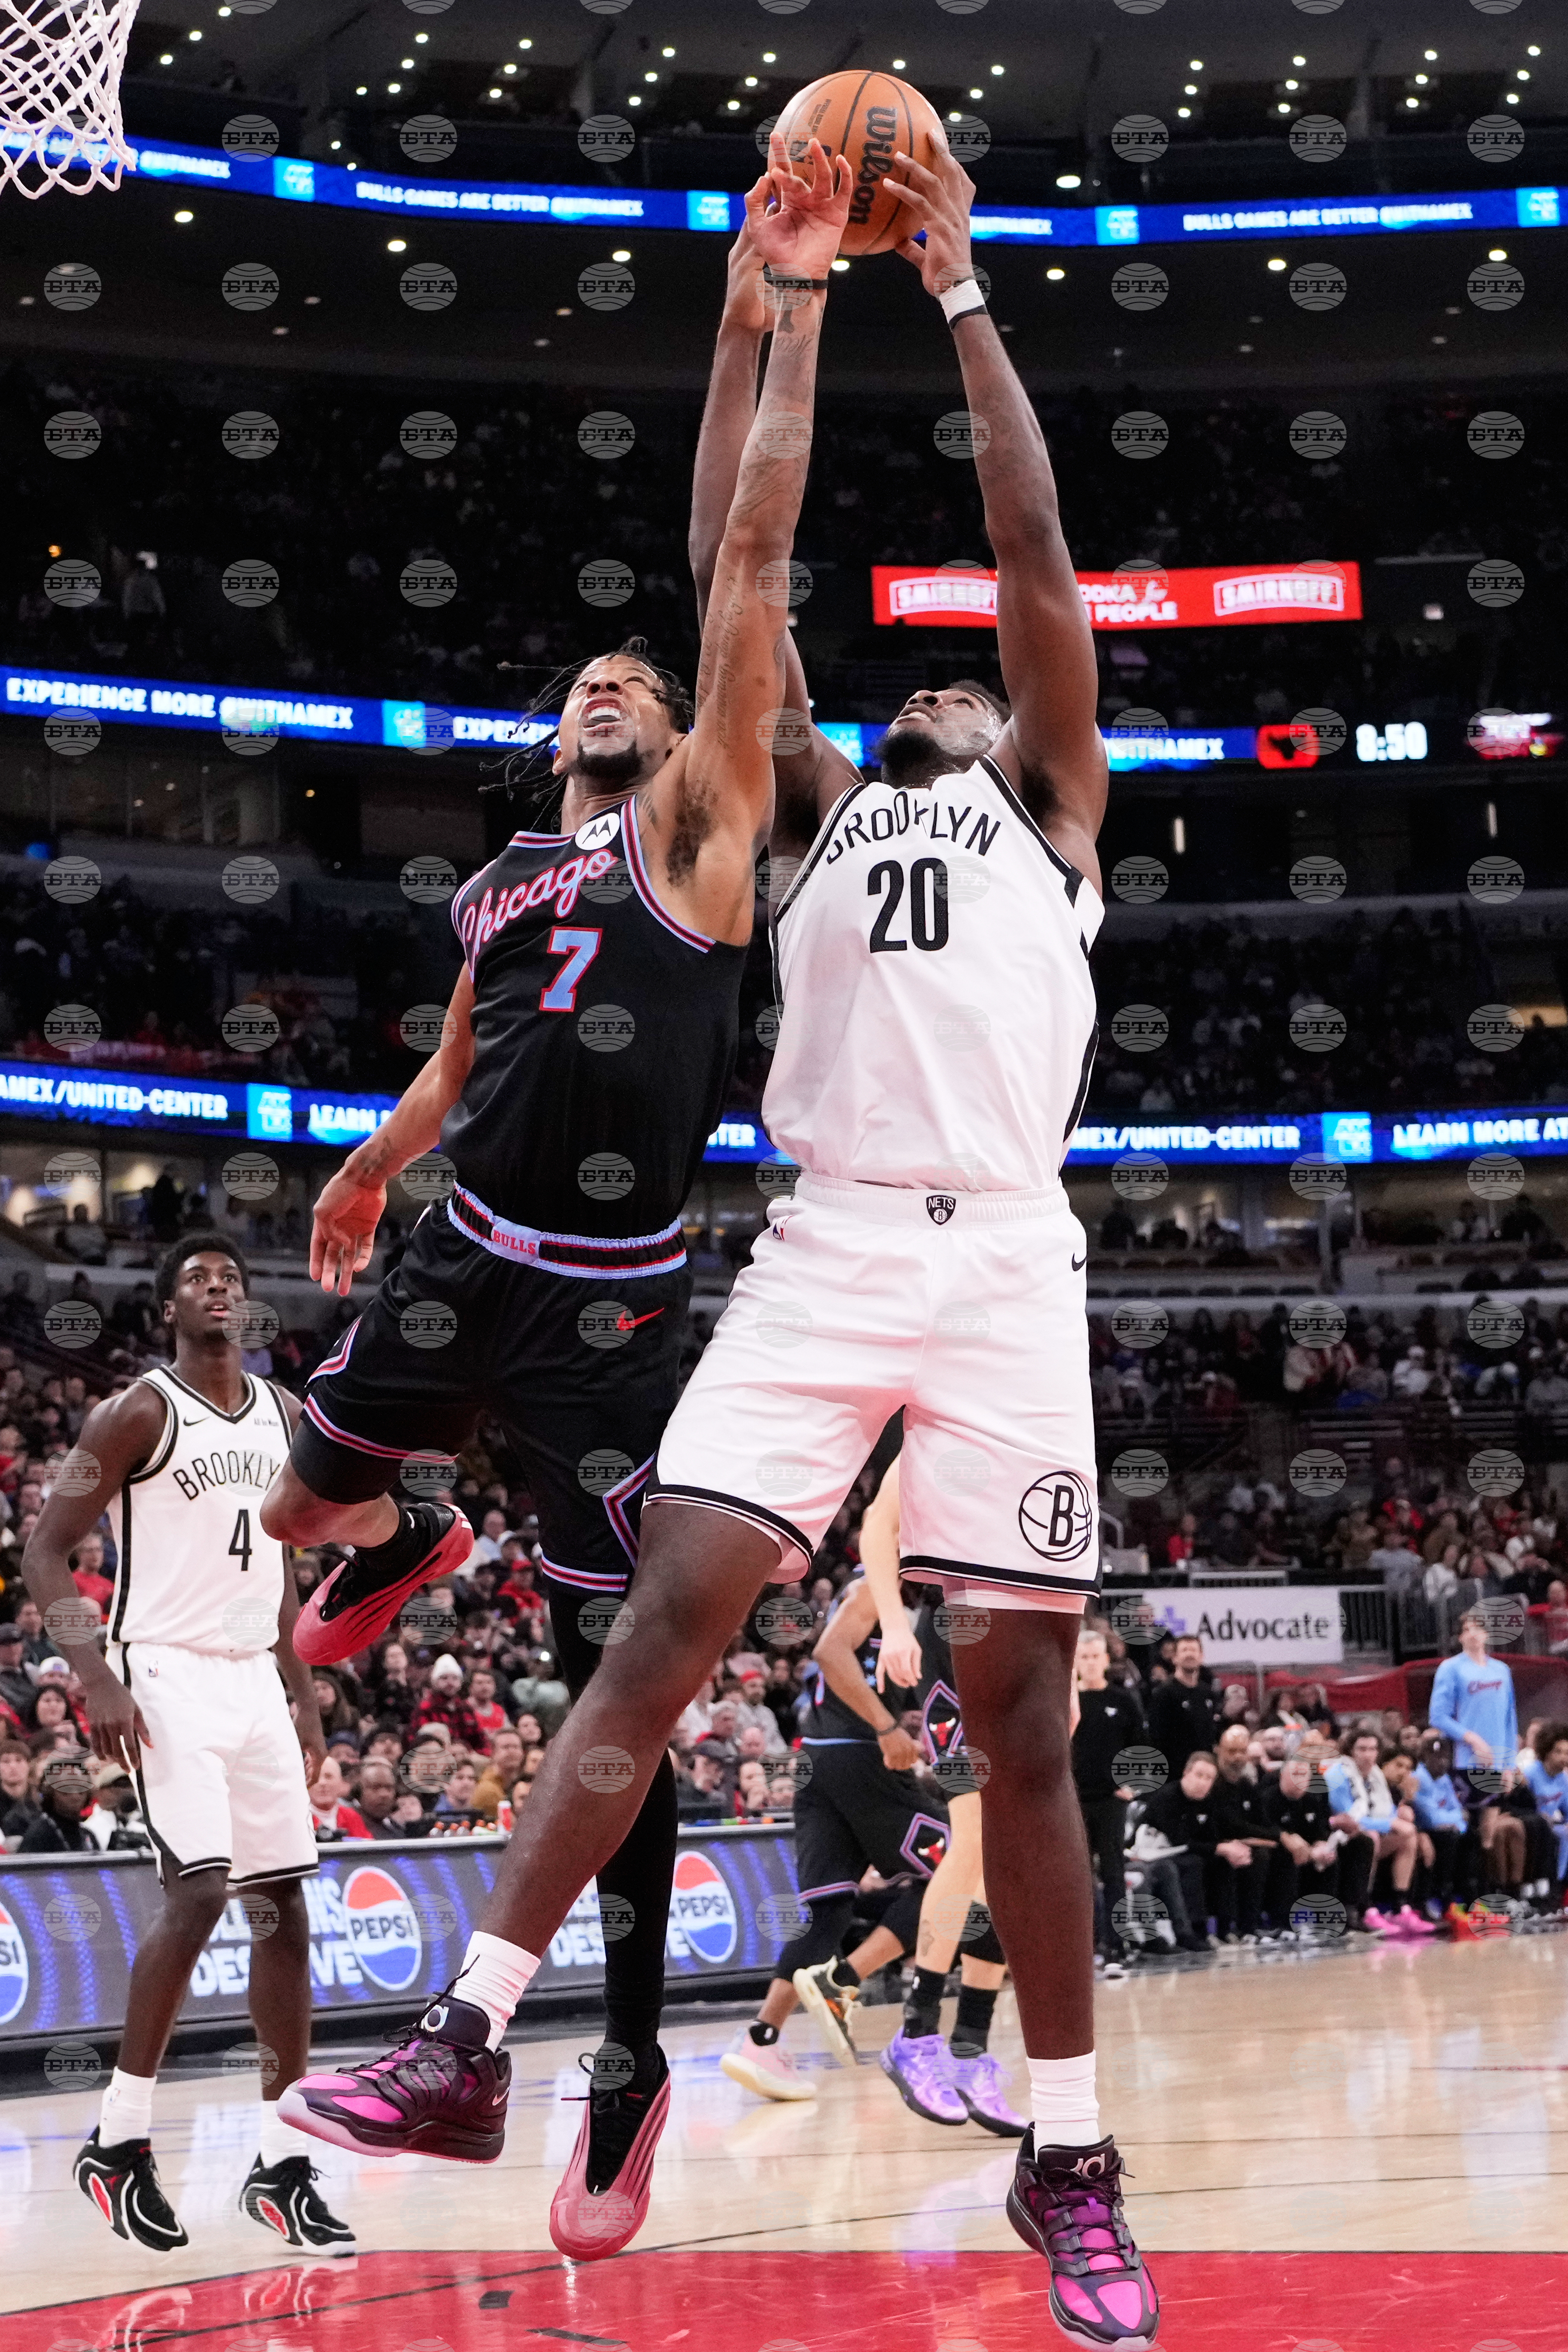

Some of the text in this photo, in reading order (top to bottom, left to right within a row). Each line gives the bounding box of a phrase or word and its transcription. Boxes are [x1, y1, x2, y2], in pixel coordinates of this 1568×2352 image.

[848, 105, 898, 224] Wilson
[6, 678, 147, 712] EXPERIENCE
[151, 690, 216, 718] MORE
[1356, 721, 1428, 762] 8:50
[462, 848, 618, 955] Chicago
[867, 857, 949, 953] 20
[539, 926, 603, 1012] 7
[309, 1103, 377, 1132] LEARN
[1393, 1122, 1470, 1147] LEARN
[1473, 1118, 1540, 1144] MORE
[928, 1197, 954, 1210] NETS
[493, 1229, 536, 1255] BULLS
[172, 1451, 281, 1501] BROOKLY
[1048, 1484, 1074, 1547] B
[228, 1509, 253, 1572] 4
[1198, 1608, 1329, 1640] Advocate
[677, 1895, 729, 1918] PEPSI
[350, 1913, 413, 1941] PEPSI
